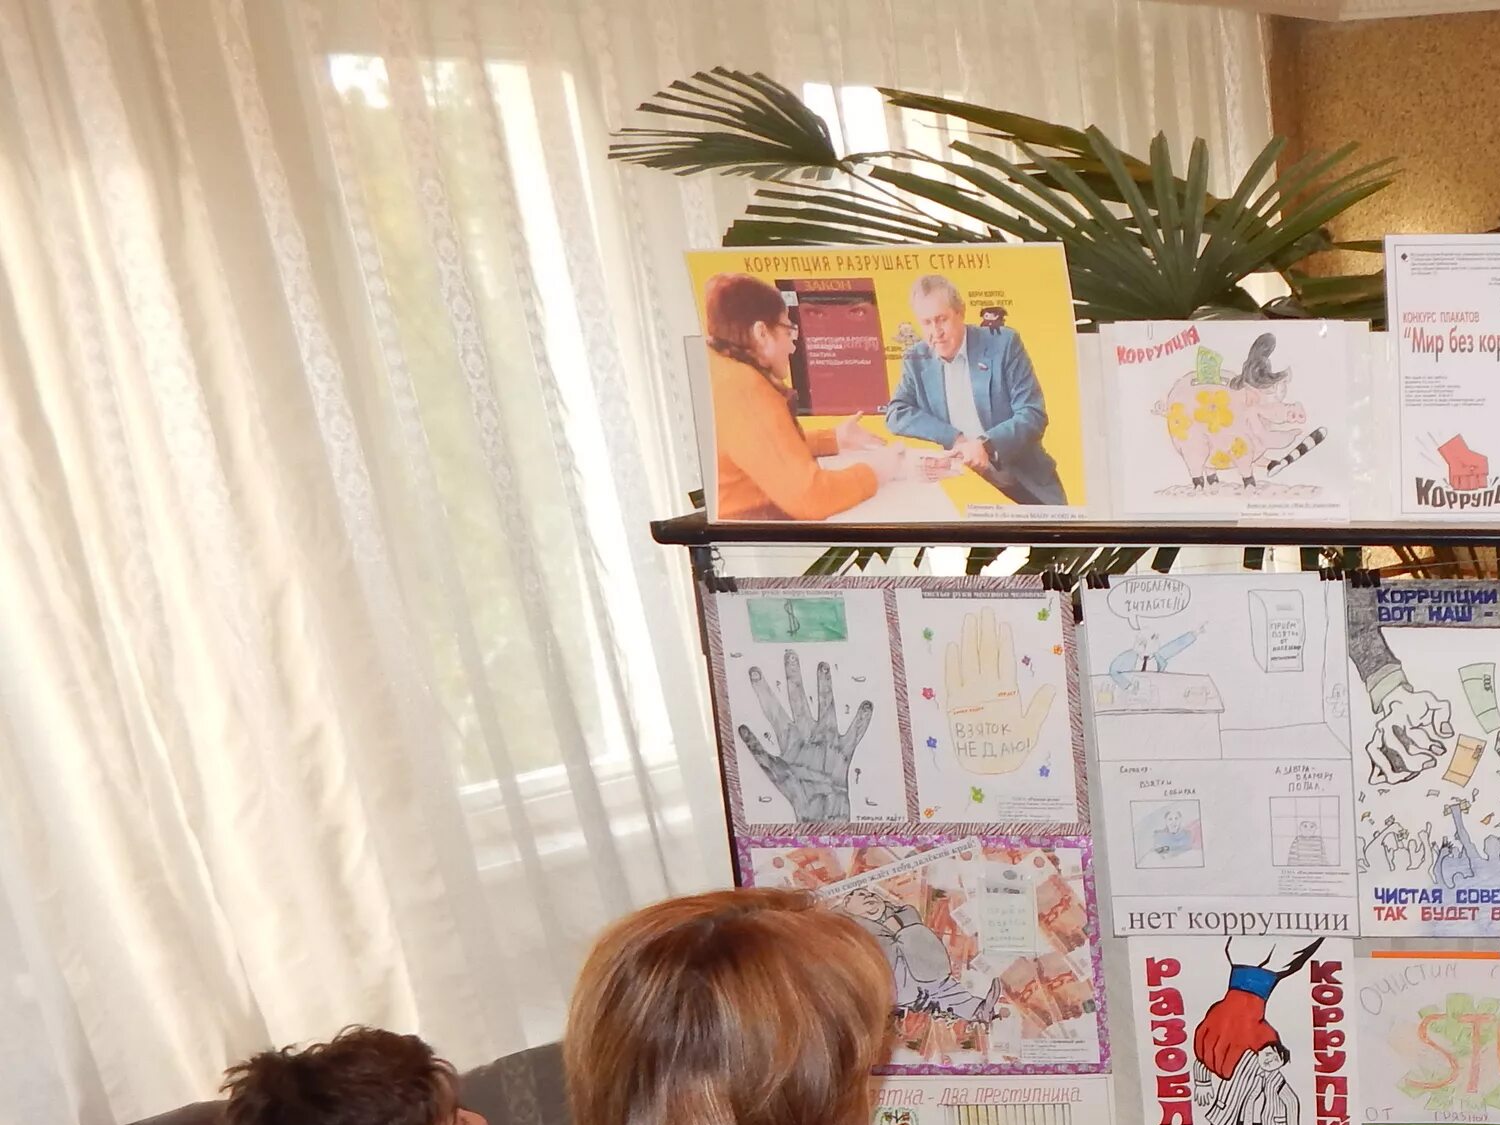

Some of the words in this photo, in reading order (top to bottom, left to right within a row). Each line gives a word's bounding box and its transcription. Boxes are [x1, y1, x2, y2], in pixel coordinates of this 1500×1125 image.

[744, 256, 831, 274] КОРРУПЦИЯ
[836, 254, 921, 272] РАЗРУШАЕТ
[929, 253, 991, 270] СТРАНУ!
[1403, 311, 1436, 323] КОНКУРС
[1440, 311, 1480, 323] ПЛАКАТОВ
[1116, 325, 1200, 365] КОРРУПЦИЯ
[1449, 326, 1474, 353] без
[1376, 588, 1498, 605] КОРРУПЦИИ
[1378, 607, 1416, 622] ВОТ
[1428, 606, 1473, 622] НАШ
[955, 722, 1012, 738] ВЗЯТОК
[956, 741, 978, 758] НЕ
[1374, 888, 1443, 904] ЧИСТАЯ
[1374, 907, 1408, 921] ТАК
[1421, 906, 1480, 921] БУДЕТ
[1188, 911, 1350, 935] коррупции
[1360, 963, 1457, 1016] ОЧИСТИМ
[1365, 1108, 1393, 1121] ОТ
